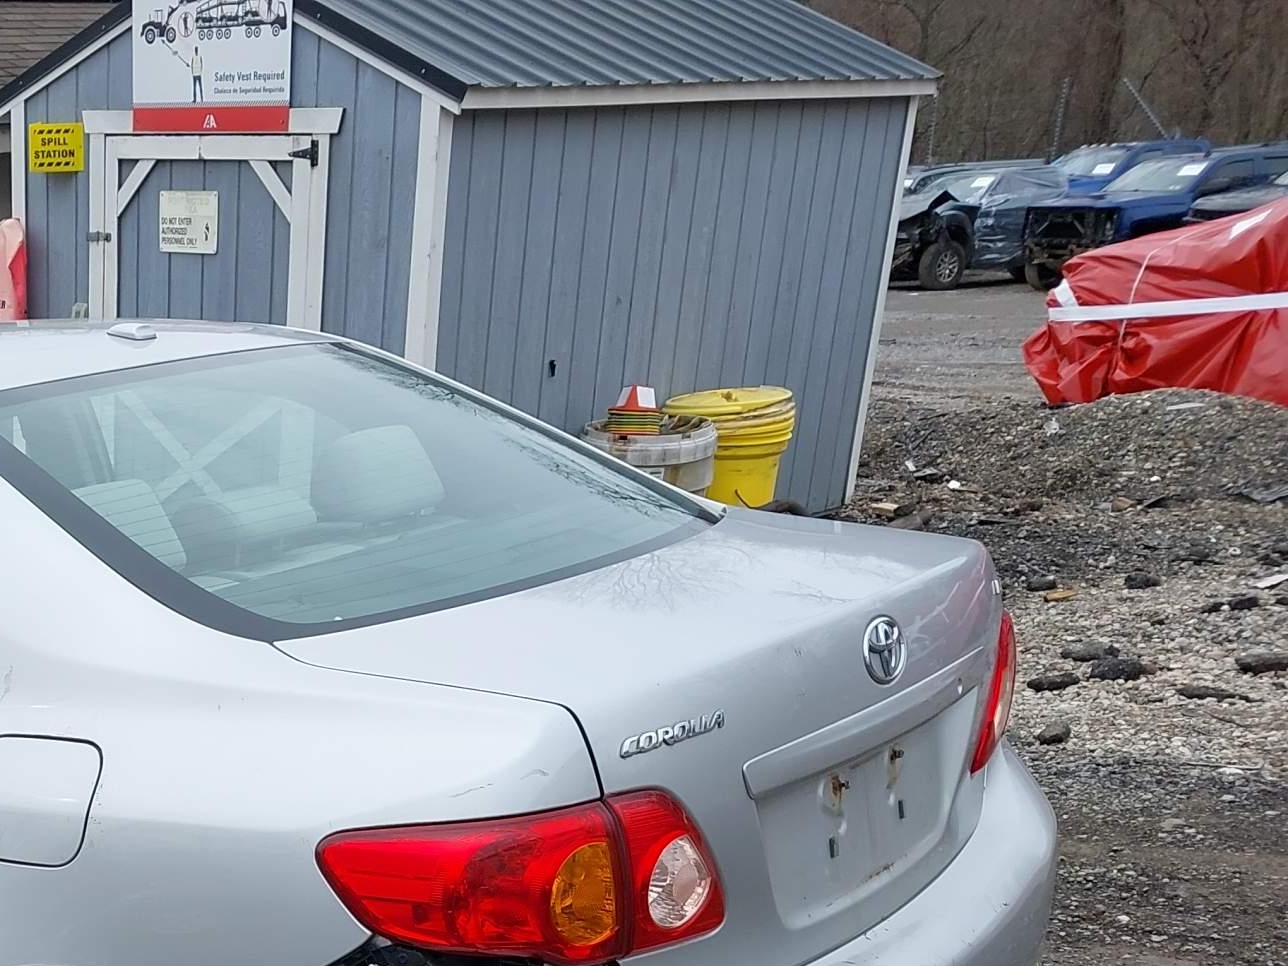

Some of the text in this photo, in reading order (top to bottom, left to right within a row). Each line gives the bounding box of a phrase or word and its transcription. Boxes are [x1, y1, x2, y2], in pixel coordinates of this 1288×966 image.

[214, 69, 285, 83] Safety Vest Required
[40, 137, 69, 147] SPILL
[34, 149, 76, 160] STATION
[161, 217, 168, 225] DO
[178, 217, 193, 226] ENTER
[619, 708, 725, 760] COROLLA
